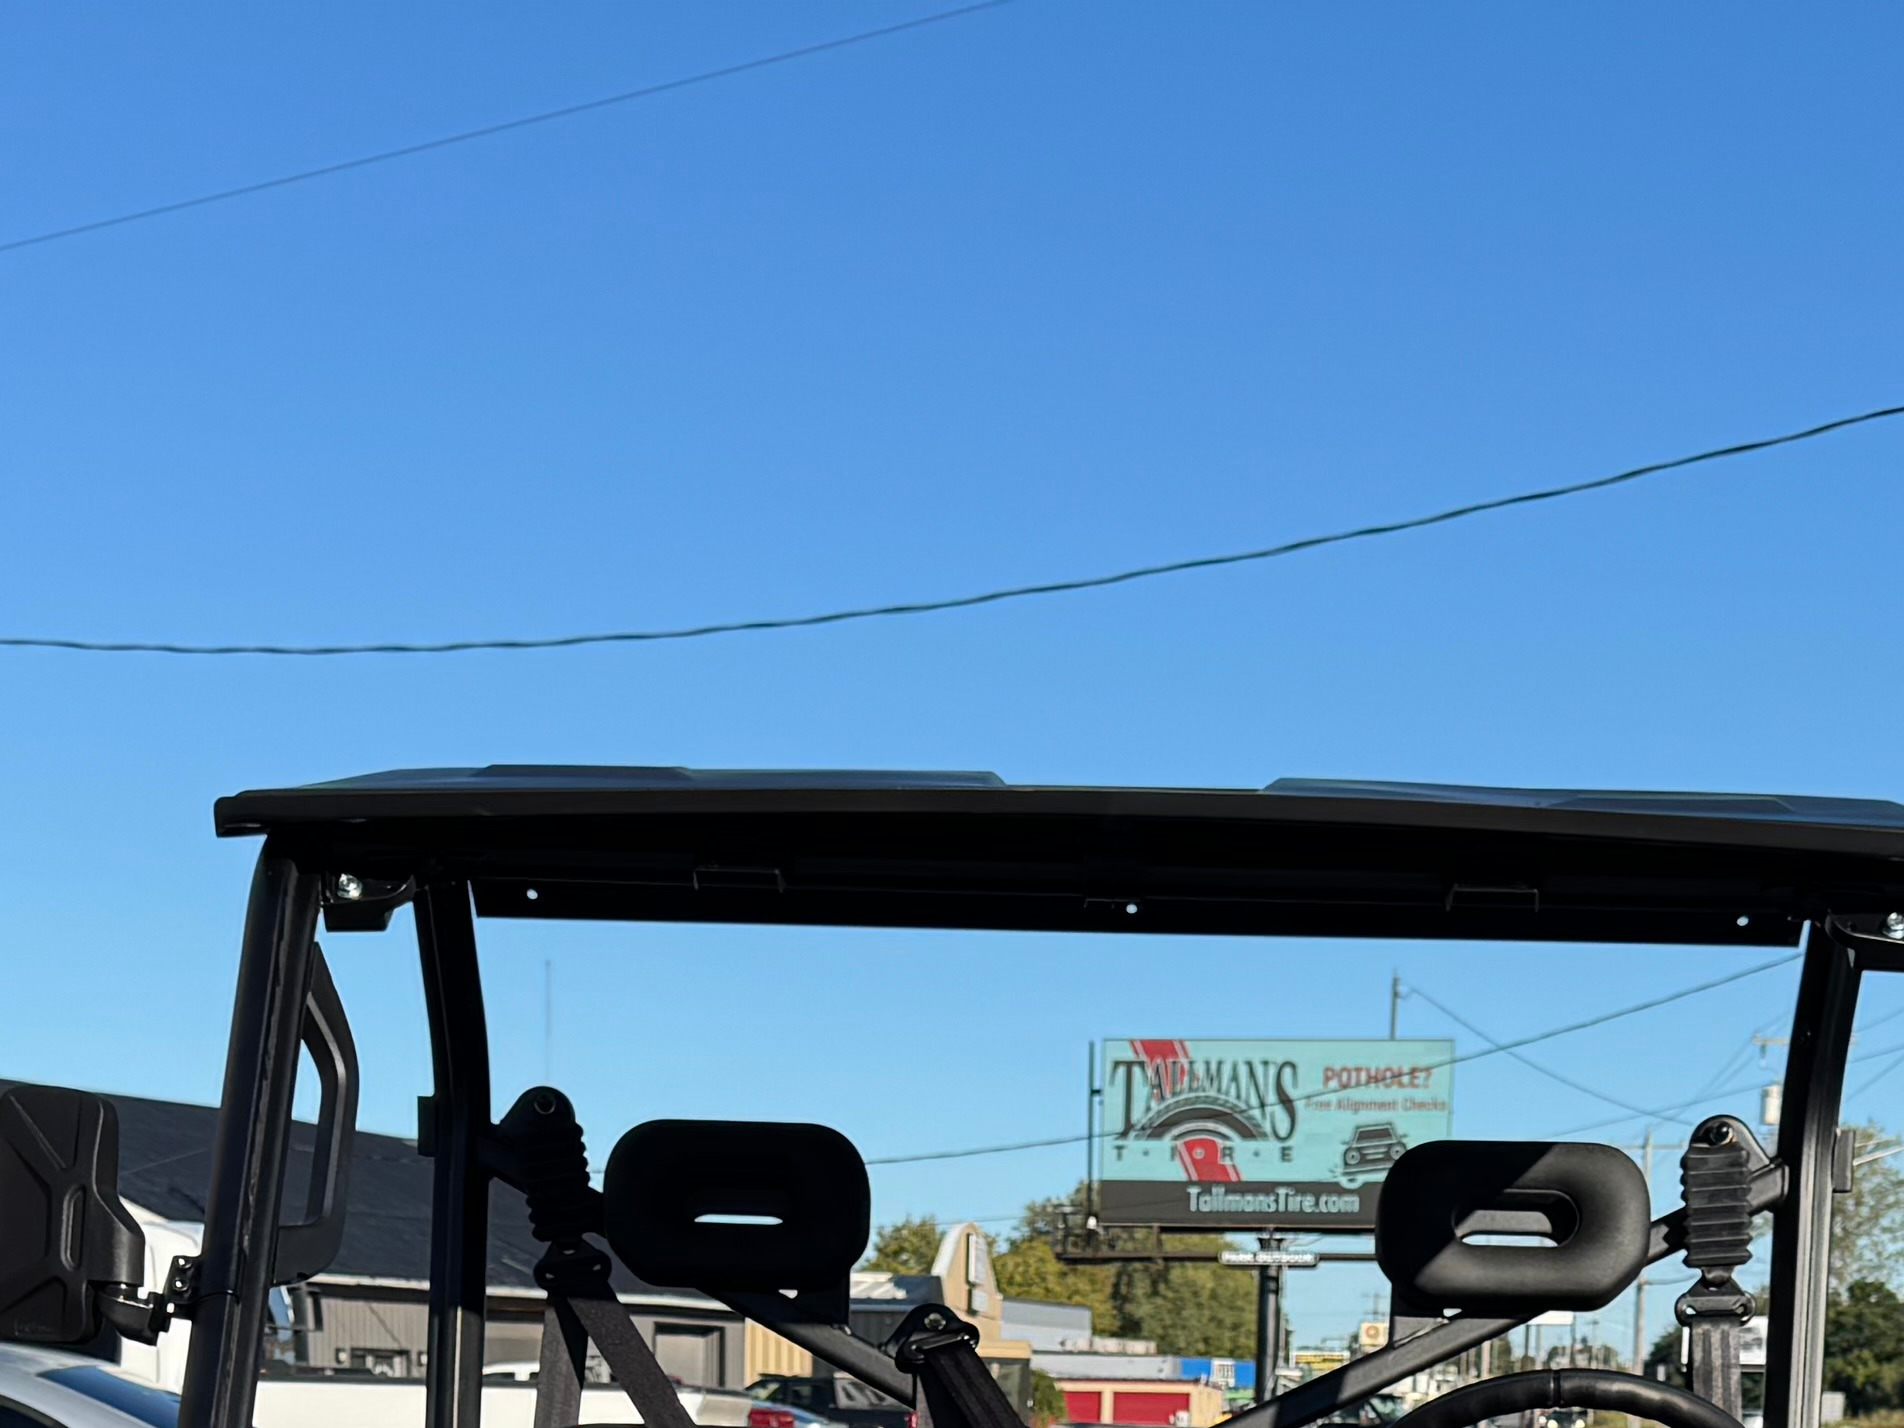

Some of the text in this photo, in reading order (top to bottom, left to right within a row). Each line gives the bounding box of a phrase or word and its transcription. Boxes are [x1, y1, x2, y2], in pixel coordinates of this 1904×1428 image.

[1322, 1065, 1434, 1089] POTHOLE?
[1108, 1060, 1299, 1142] TALLMANS
[1336, 1098, 1397, 1114] Alignment
[1186, 1184, 1361, 1213] TallmansTire.com
